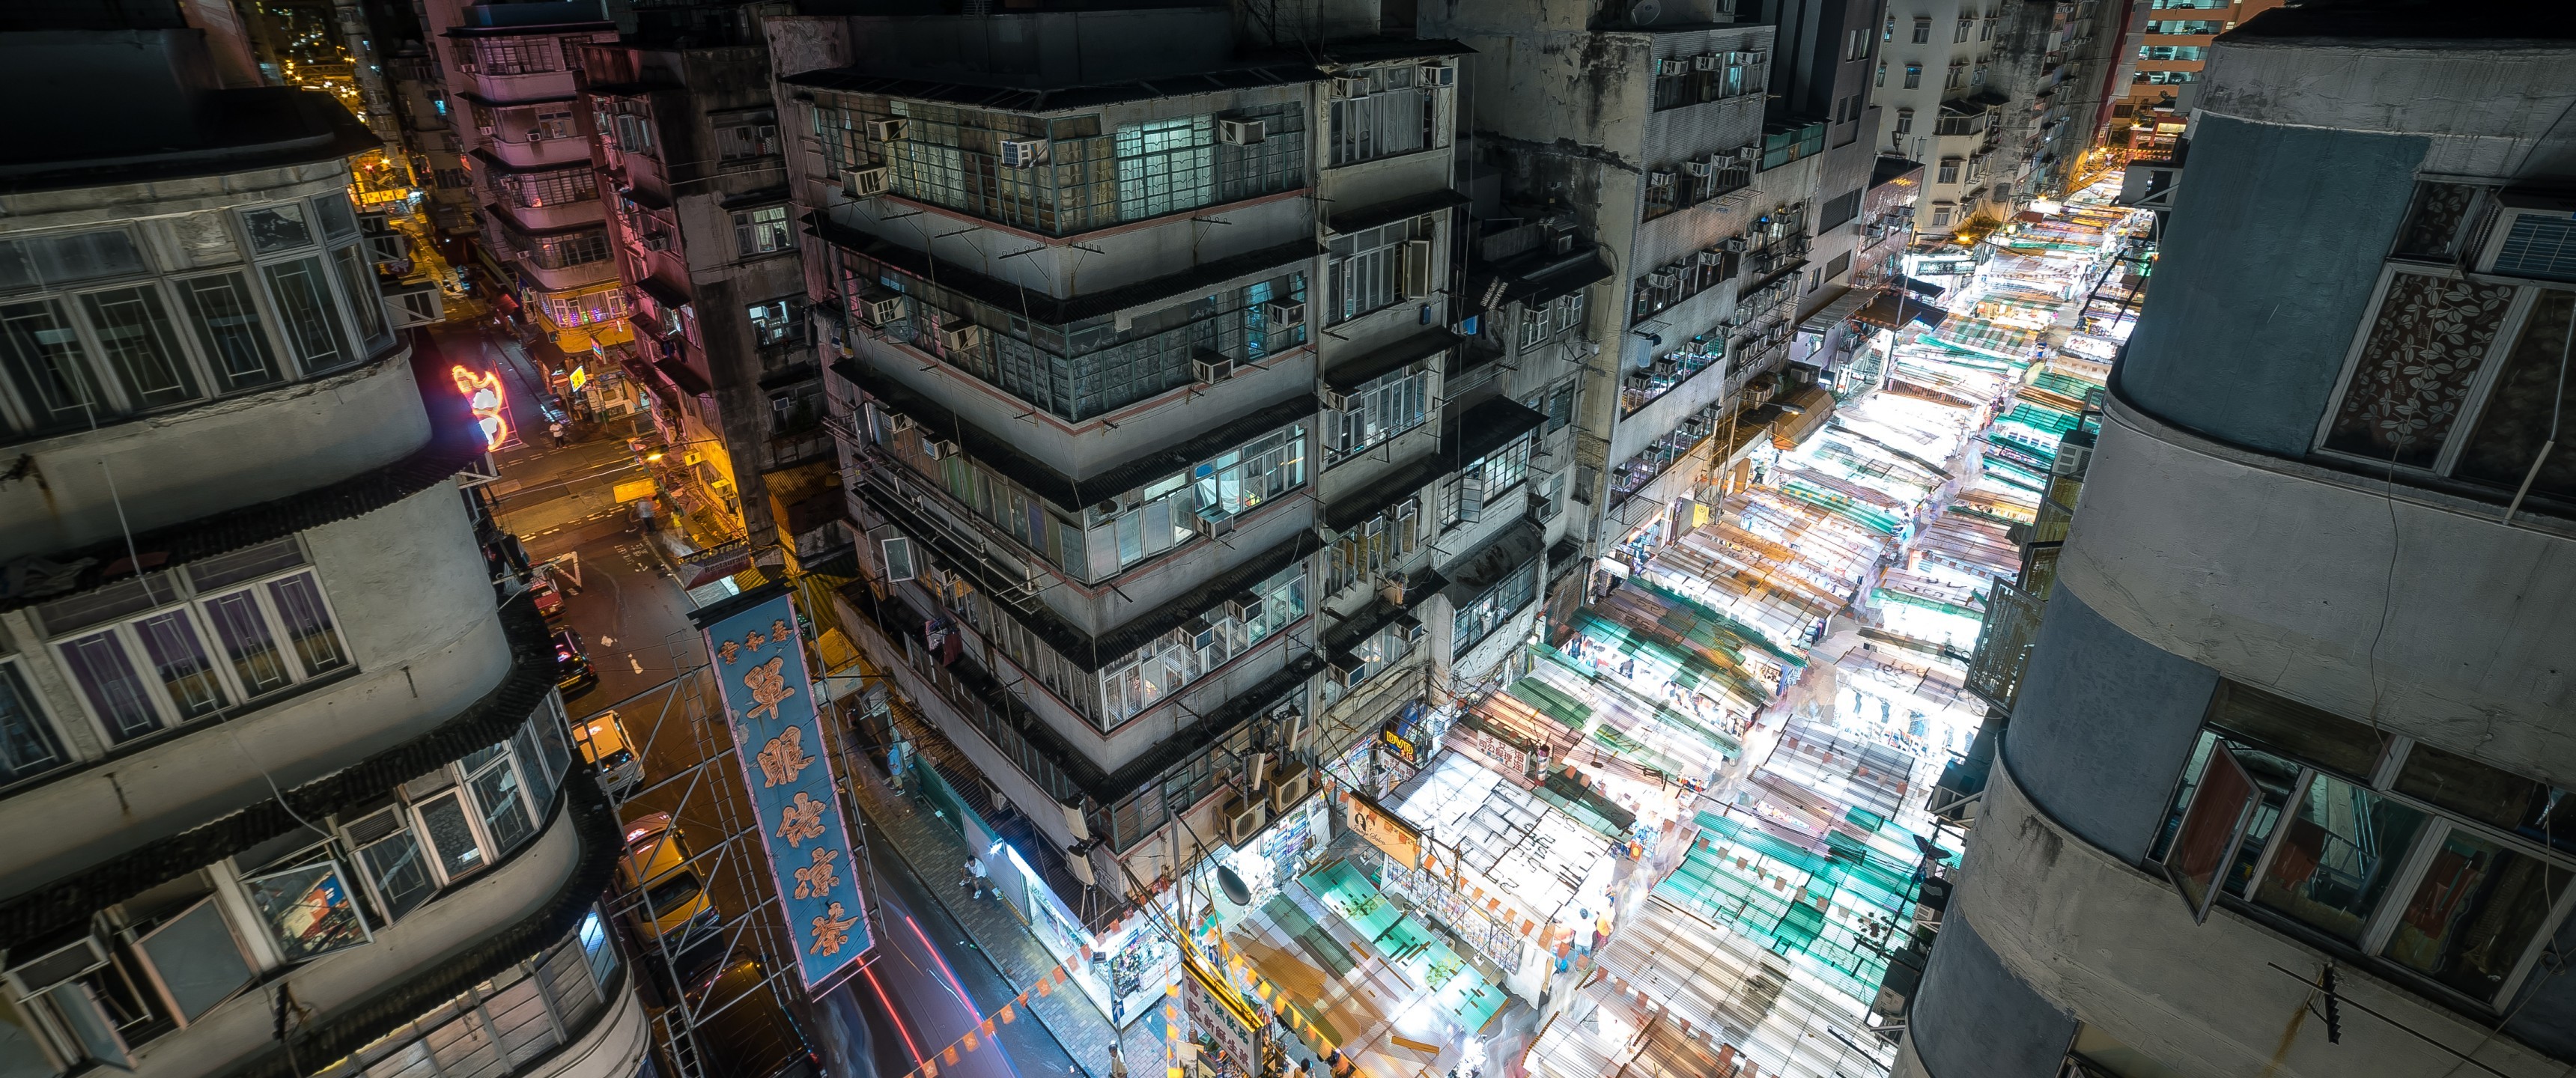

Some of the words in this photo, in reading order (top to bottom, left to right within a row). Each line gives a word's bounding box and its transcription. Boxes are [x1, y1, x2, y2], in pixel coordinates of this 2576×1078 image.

[705, 554, 749, 574] Restaurant
[1386, 731, 1413, 755] DVD
[1351, 823, 1369, 838] Image
[1370, 832, 1386, 845] Salon
[1203, 992, 1250, 1046] 天然飲品
